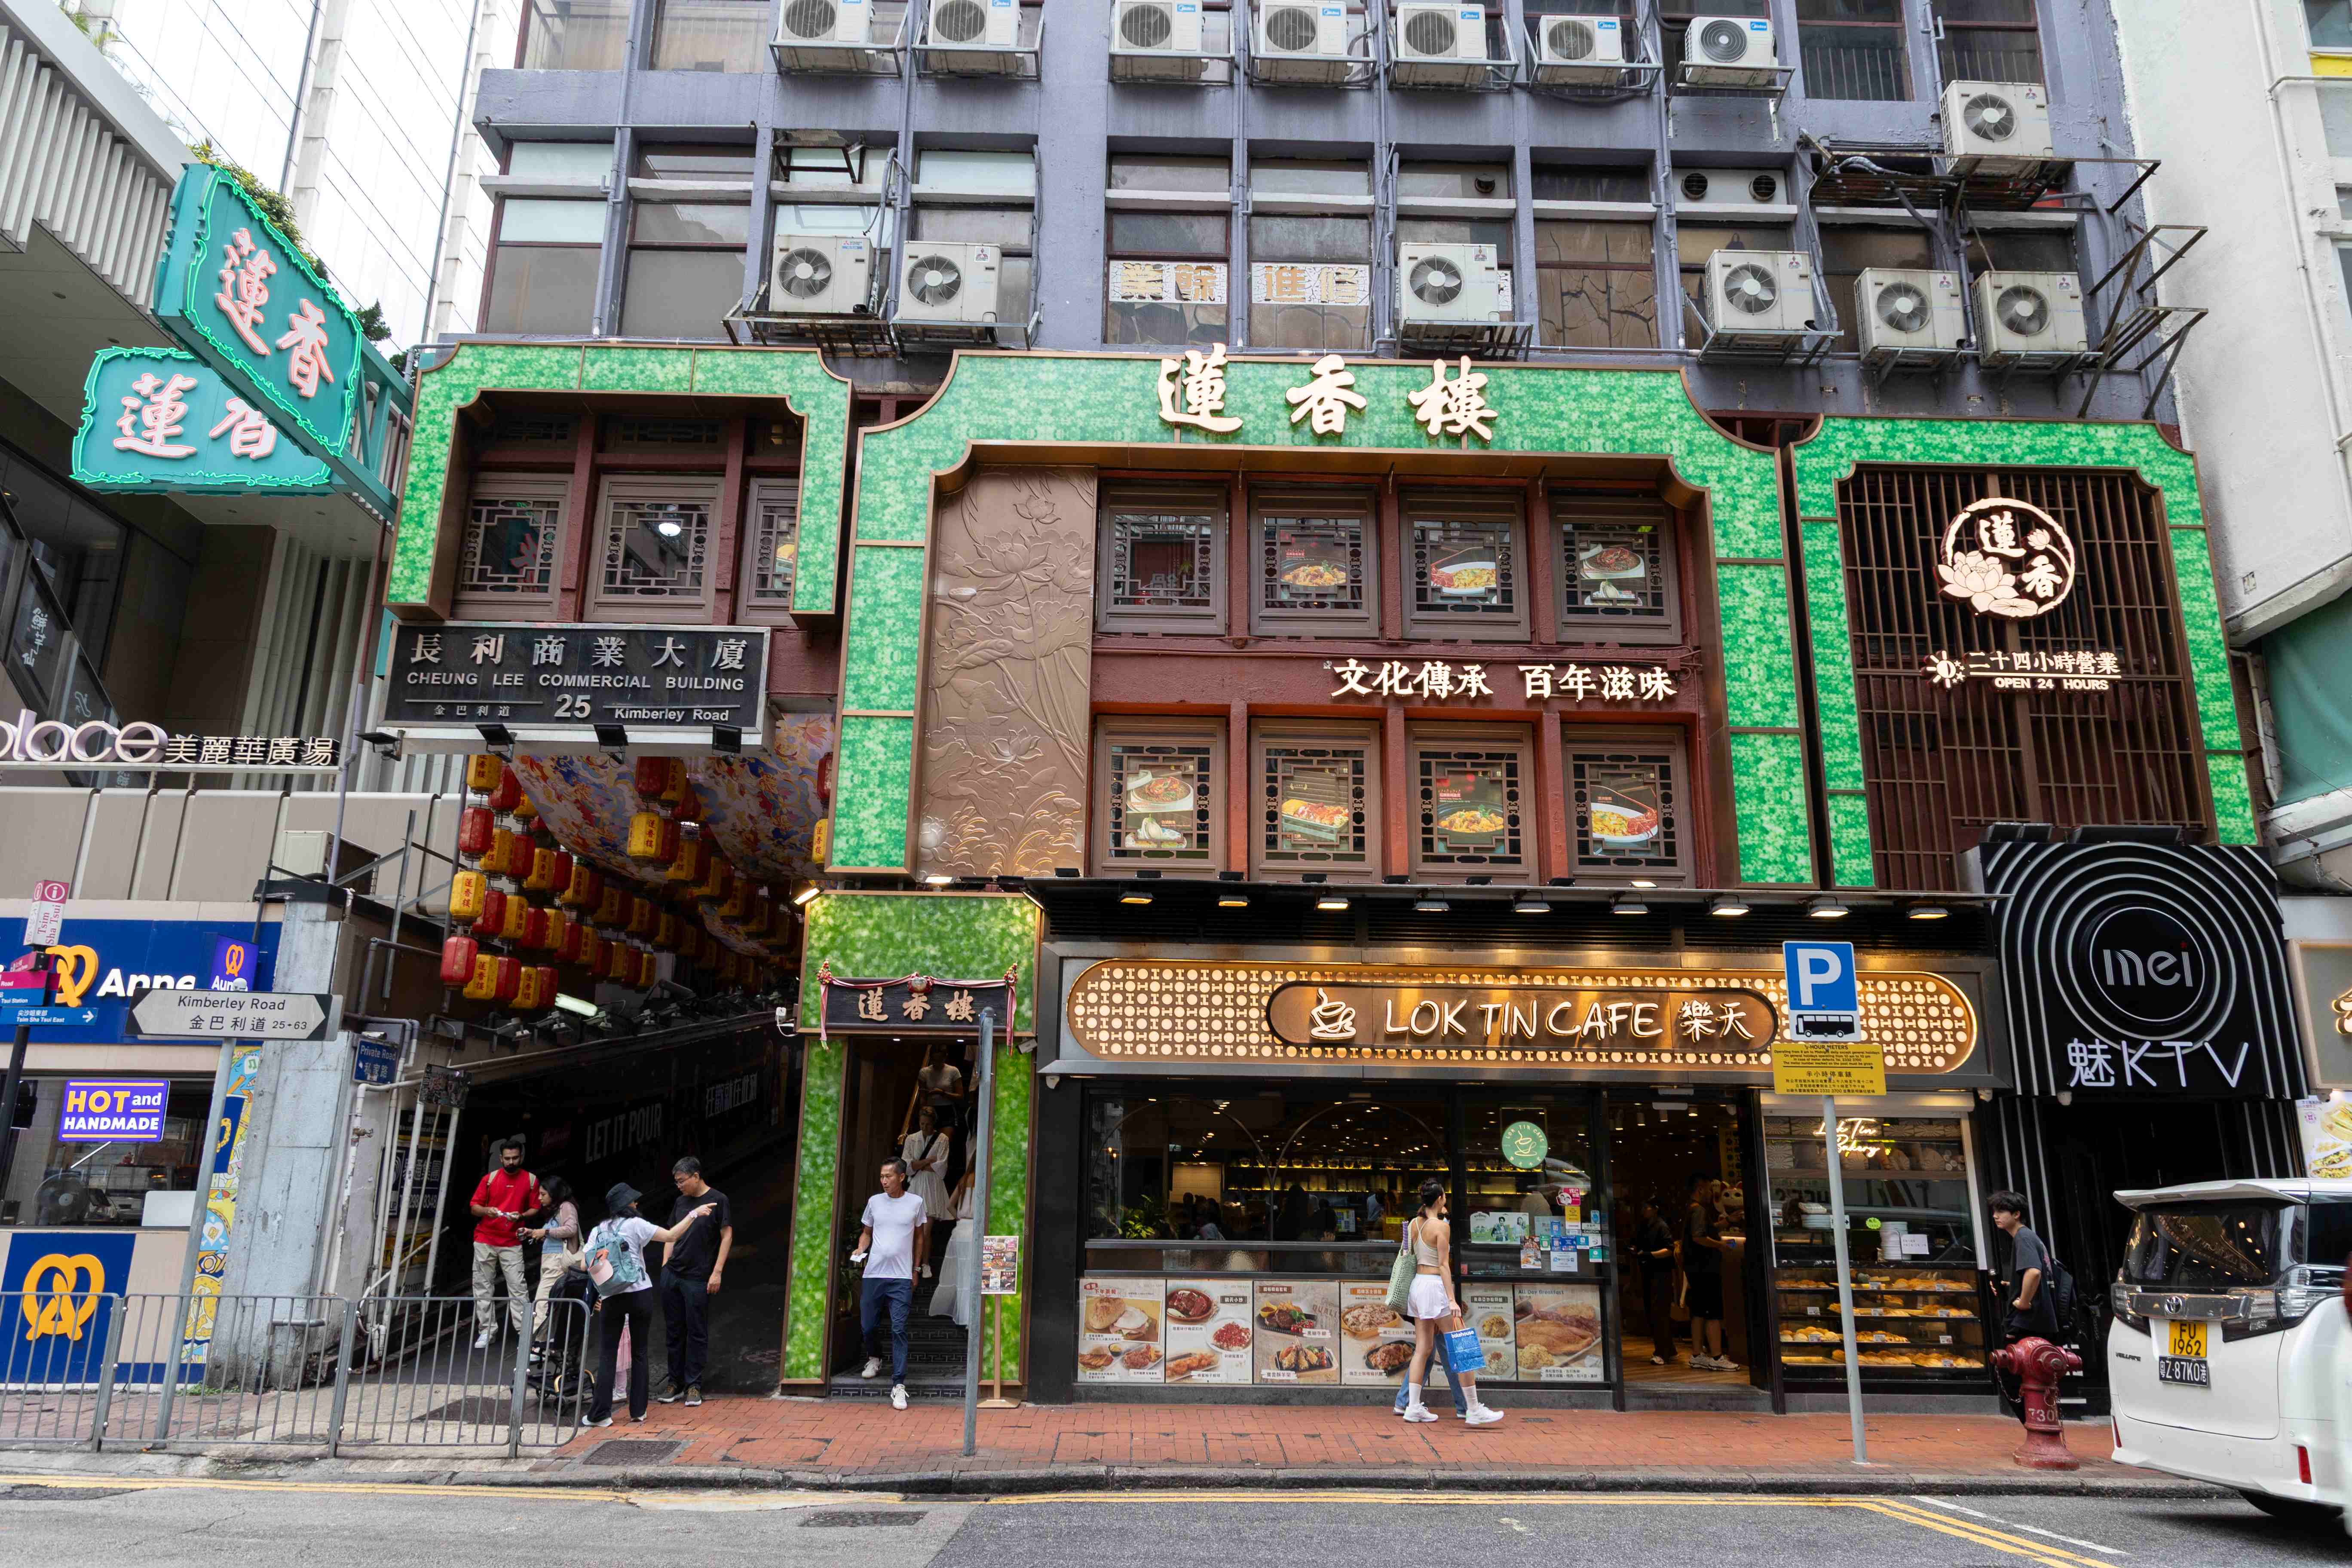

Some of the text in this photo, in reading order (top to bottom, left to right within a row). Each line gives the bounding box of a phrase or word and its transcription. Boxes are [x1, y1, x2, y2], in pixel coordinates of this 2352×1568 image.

[215, 228, 334, 398] 蓮香
[1159, 342, 1498, 444] 蓮香樓
[1978, 510, 2062, 598] 蓮香
[410, 633, 747, 670] 長利商業大廈
[1968, 651, 2122, 674] 二十四小時營業
[407, 672, 744, 691] CHEUNG LEE COMMERCIAL BUILDING
[1331, 658, 1677, 700] 文化傳承 百年滋味
[1994, 677, 2108, 690] OPEN 24 HOURS
[434, 705, 510, 717] 金巴利道
[554, 694, 591, 718] 25
[615, 708, 729, 722] Kimberley Road
[165, 734, 334, 766] 美麗華廣場
[38, 912, 49, 935] Tsim
[46, 904, 61, 945] Sha Tsui
[2102, 942, 2193, 987] mei
[211, 975, 248, 992] Aun
[1796, 949, 1841, 1005] P
[178, 995, 285, 1011] Kimberley Road
[859, 987, 976, 1023] 蓮香樓
[190, 1016, 265, 1031] 金巴利道
[1385, 999, 1663, 1039] LOK TIN CAFE
[1678, 999, 1755, 1041] 樂天
[361, 1045, 396, 1060] Private Road
[67, 1091, 162, 1113] HOT and
[64, 1117, 159, 1130] HANDMADE
[585, 1118, 612, 1165] LET
[612, 1114, 626, 1154] IT
[628, 1103, 662, 1147] POUR
[1813, 1118, 1877, 1139] Lk Tin
[1836, 1134, 1880, 1157] Bakery
[1451, 1330, 1474, 1338] bakehouse
[2180, 1323, 2196, 1339] FU
[2173, 1338, 2201, 1356] 1962
